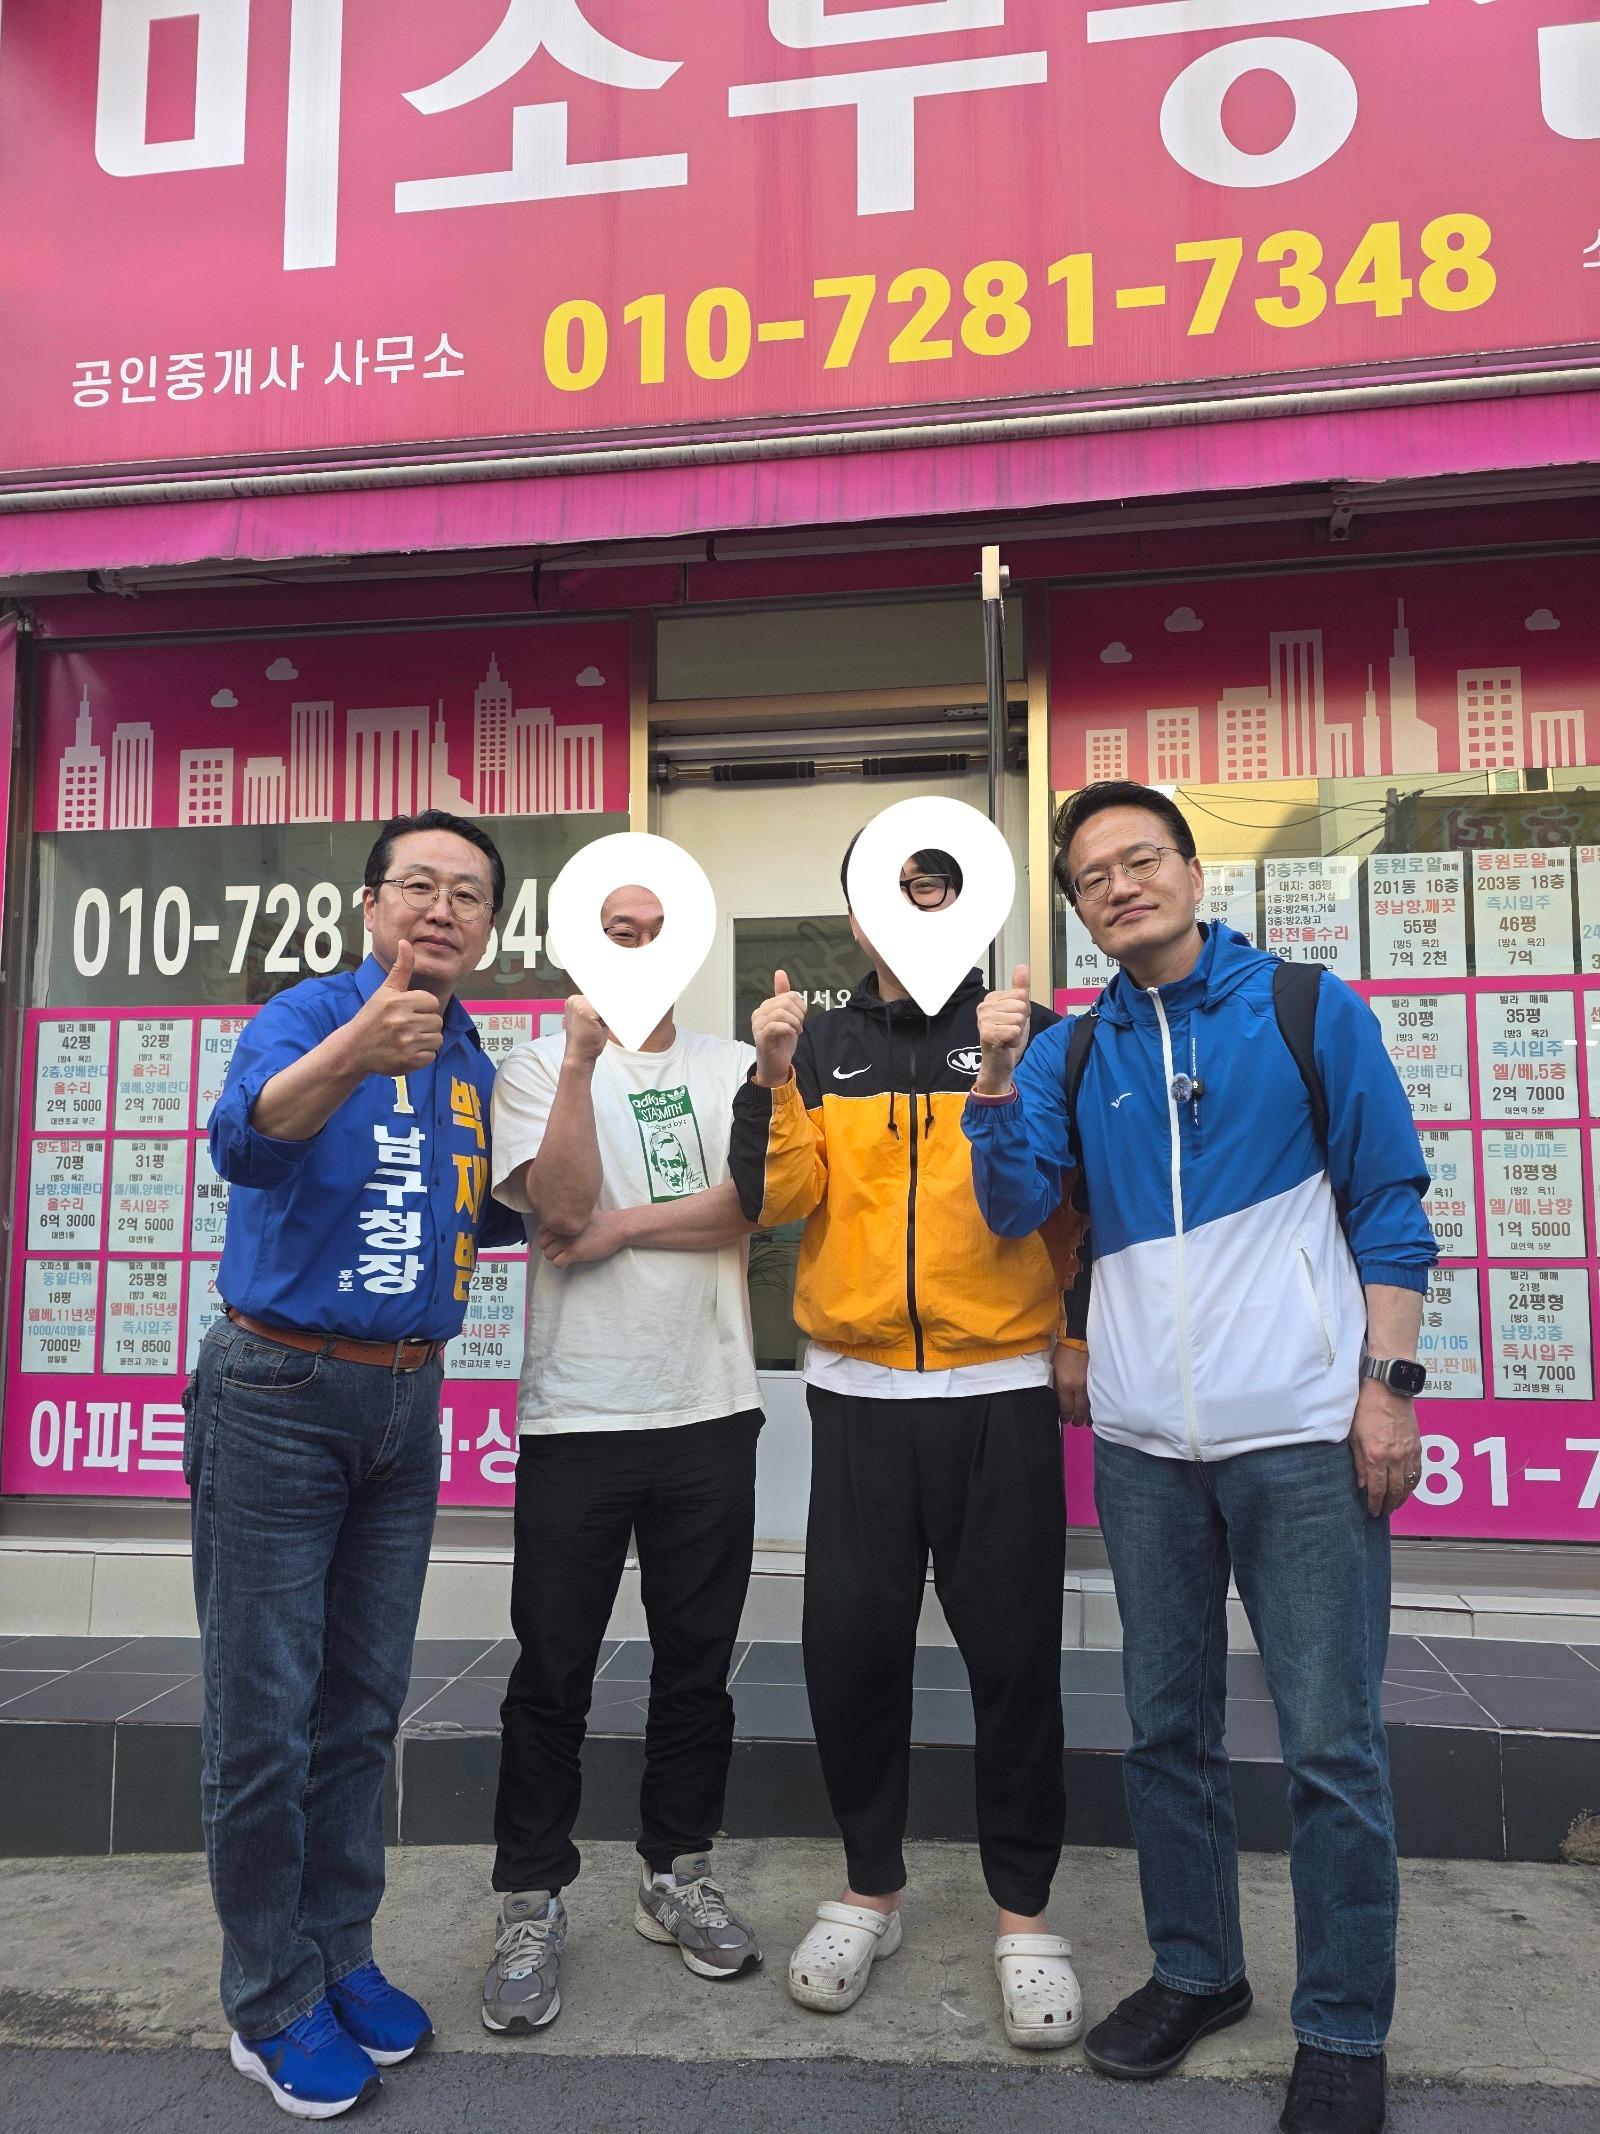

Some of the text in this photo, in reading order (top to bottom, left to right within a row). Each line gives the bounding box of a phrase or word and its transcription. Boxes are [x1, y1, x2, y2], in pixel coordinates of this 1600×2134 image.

[543, 213, 1497, 391] 010-7281-7348
[72, 332, 466, 408] 공인중개사 사무소
[1477, 852, 1547, 870] 동원로얄
[1580, 848, 1600, 863] 일
[1267, 861, 1322, 878] 3층주택
[1374, 857, 1442, 874] 동원로얄
[1280, 880, 1332, 891] 대지: 36평
[1374, 878, 1459, 894] 201동 16층
[1478, 874, 1564, 891] 203동 18층
[1375, 899, 1456, 915] 정남향,깨끗
[1487, 895, 1551, 910] 즉시입주
[1404, 919, 1436, 934] 55평
[1500, 916, 1536, 932] 46평
[1269, 926, 1348, 942] 완전올수리
[1302, 946, 1337, 960] 1000
[1390, 951, 1447, 966] 7억 2천
[1508, 950, 1532, 965] 7억
[1075, 955, 1098, 968] 4억
[1500, 995, 1518, 1004] 빌라
[1398, 1011, 1433, 1027] 30평
[1507, 1008, 1540, 1023] 35평
[488, 1017, 525, 1030] 올전세
[62, 1035, 90, 1049] 42평
[141, 1034, 169, 1048] 32평
[1390, 1045, 1437, 1060] 수리함
[1492, 1040, 1563, 1057] 즉시입주
[133, 1064, 169, 1077] 올수리
[1493, 1063, 1566, 1080] 엘/베,5층
[54, 1082, 90, 1094] 올수리
[1407, 1083, 1430, 1098] 2억
[1493, 1086, 1564, 1101] 2억 7000
[47, 1100, 101, 1112] 2억 5000
[125, 1098, 180, 1111] 2억 7000
[1444, 1103, 1452, 1111] 길
[1505, 1131, 1524, 1140] 빌라
[1487, 1144, 1568, 1158] 드림아파트
[56, 1156, 84, 1170] 70평
[136, 1154, 164, 1168] 31평
[1503, 1164, 1557, 1180] 18평형
[48, 1198, 84, 1211] 올수리
[119, 1200, 169, 1213] 즉시입주
[356, 1124, 428, 1295] 남구청장
[1490, 1198, 1573, 1215] 엘/베,남향
[40, 1214, 95, 1227] 6억 3000
[118, 1218, 173, 1230] 2억 5000
[1498, 1221, 1570, 1237] 1억 5000
[490, 1264, 508, 1274] 월세
[1510, 1271, 1528, 1280] 빌라
[43, 1272, 92, 1285] 동일타워
[128, 1273, 167, 1286] 25평형
[337, 1269, 355, 1292] 후보
[1433, 1271, 1454, 1282] 임대
[1520, 1282, 1540, 1292] 21평
[48, 1292, 71, 1304] 18평
[1509, 1294, 1563, 1311] 24평형
[111, 1303, 177, 1316] 엘베,15년생
[122, 1321, 173, 1335] 즉시입주
[1501, 1325, 1562, 1341] 남향,3층
[40, 1339, 81, 1352] 7000만
[116, 1340, 171, 1353] 1억 8500
[461, 1343, 502, 1356] 1억/40
[1503, 1344, 1574, 1361] 즉시입주
[450, 1360, 511, 1368] 유엔교차로 부근
[1503, 1364, 1575, 1380] 1억 7000
[1513, 1383, 1564, 1393] 고려병원 뒤
